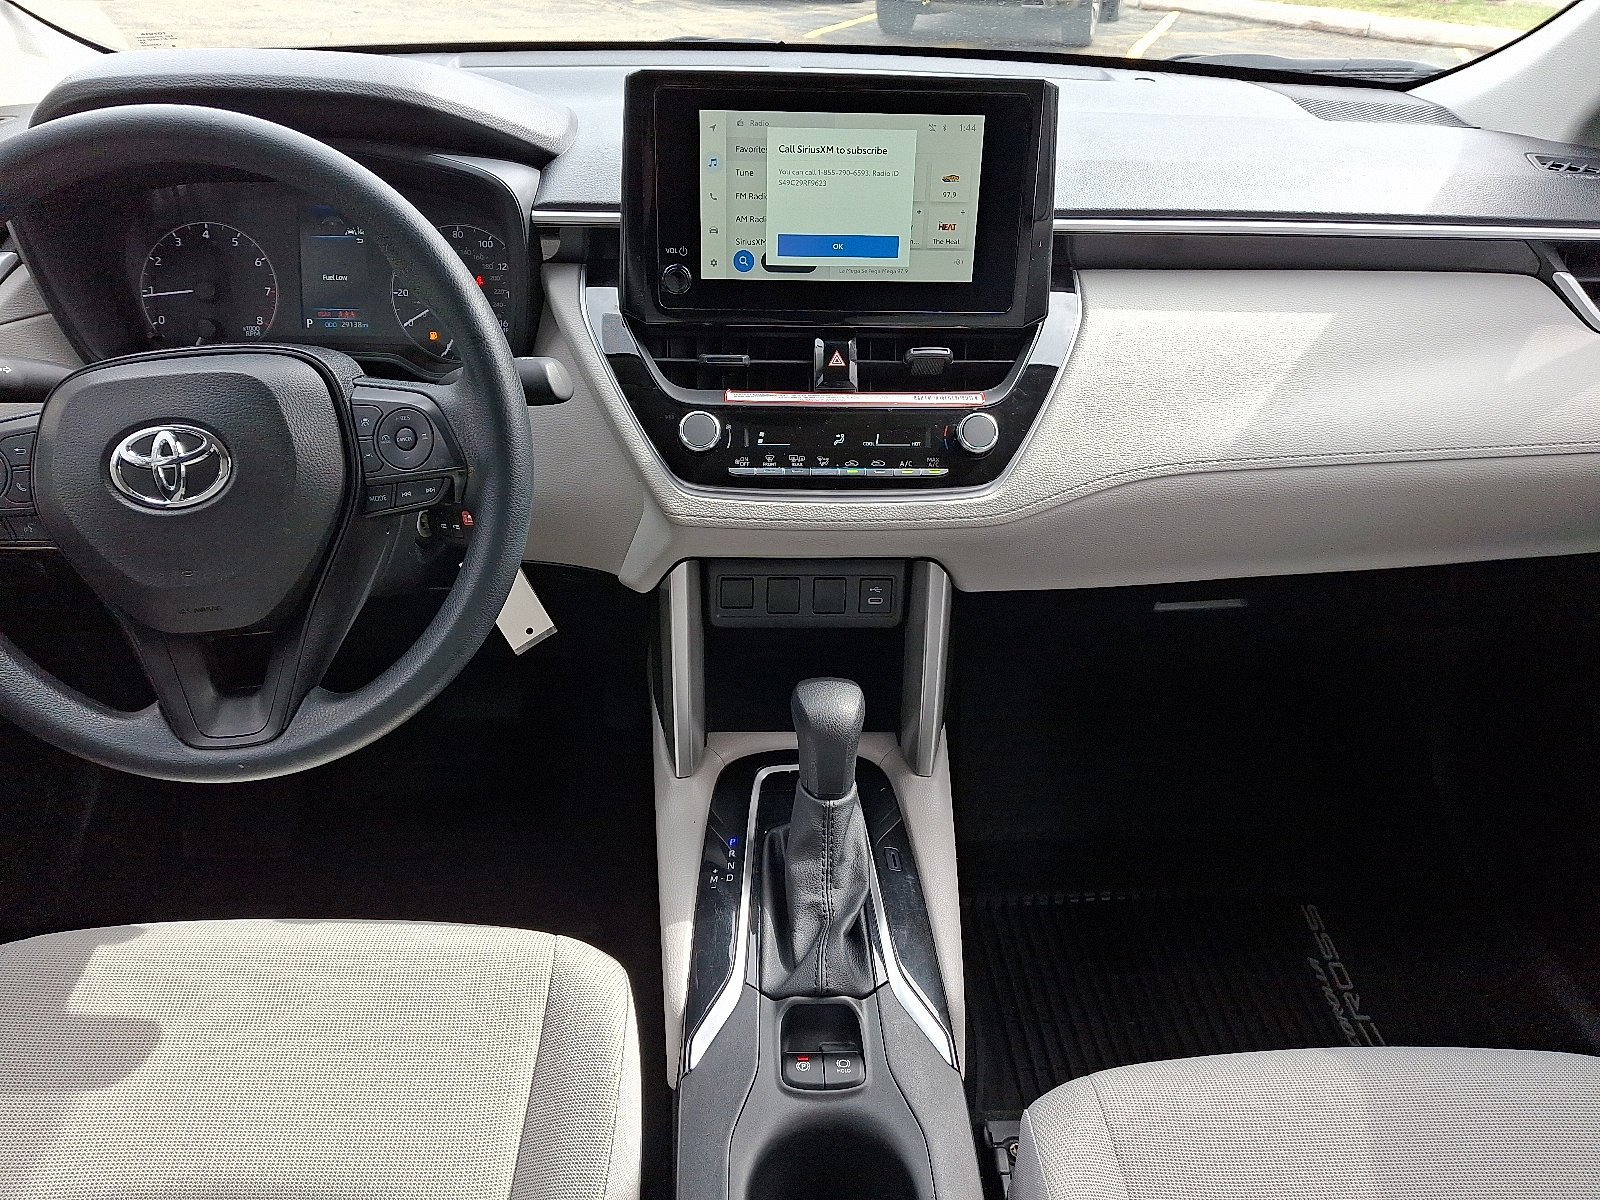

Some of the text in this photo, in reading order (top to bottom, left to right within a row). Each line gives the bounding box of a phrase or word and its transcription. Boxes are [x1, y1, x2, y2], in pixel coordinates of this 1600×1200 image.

[750, 119, 770, 127] Radio
[959, 123, 977, 132] 1:44
[778, 144, 888, 155] Call SiriusXM to subscribe
[735, 169, 754, 177] Tune
[942, 191, 957, 199] 97.9
[937, 223, 957, 231] HEAT
[202, 229, 210, 239] 4
[452, 230, 464, 239] 80
[175, 237, 182, 247] 3
[231, 237, 239, 247] 5
[478, 240, 493, 249] 100
[154, 256, 162, 266] 2
[254, 257, 262, 267] 6
[498, 262, 509, 271] 12
[264, 286, 271, 296] 7
[397, 288, 409, 297] 20
[158, 315, 165, 325] 0
[256, 316, 264, 325] 8
[306, 318, 313, 329] P
[899, 460, 913, 468] A/C
[369, 494, 388, 502] MODE
[728, 837, 737, 847] P
[728, 849, 737, 858] R
[727, 861, 736, 870] N
[709, 874, 719, 884] M
[725, 873, 735, 883] D
